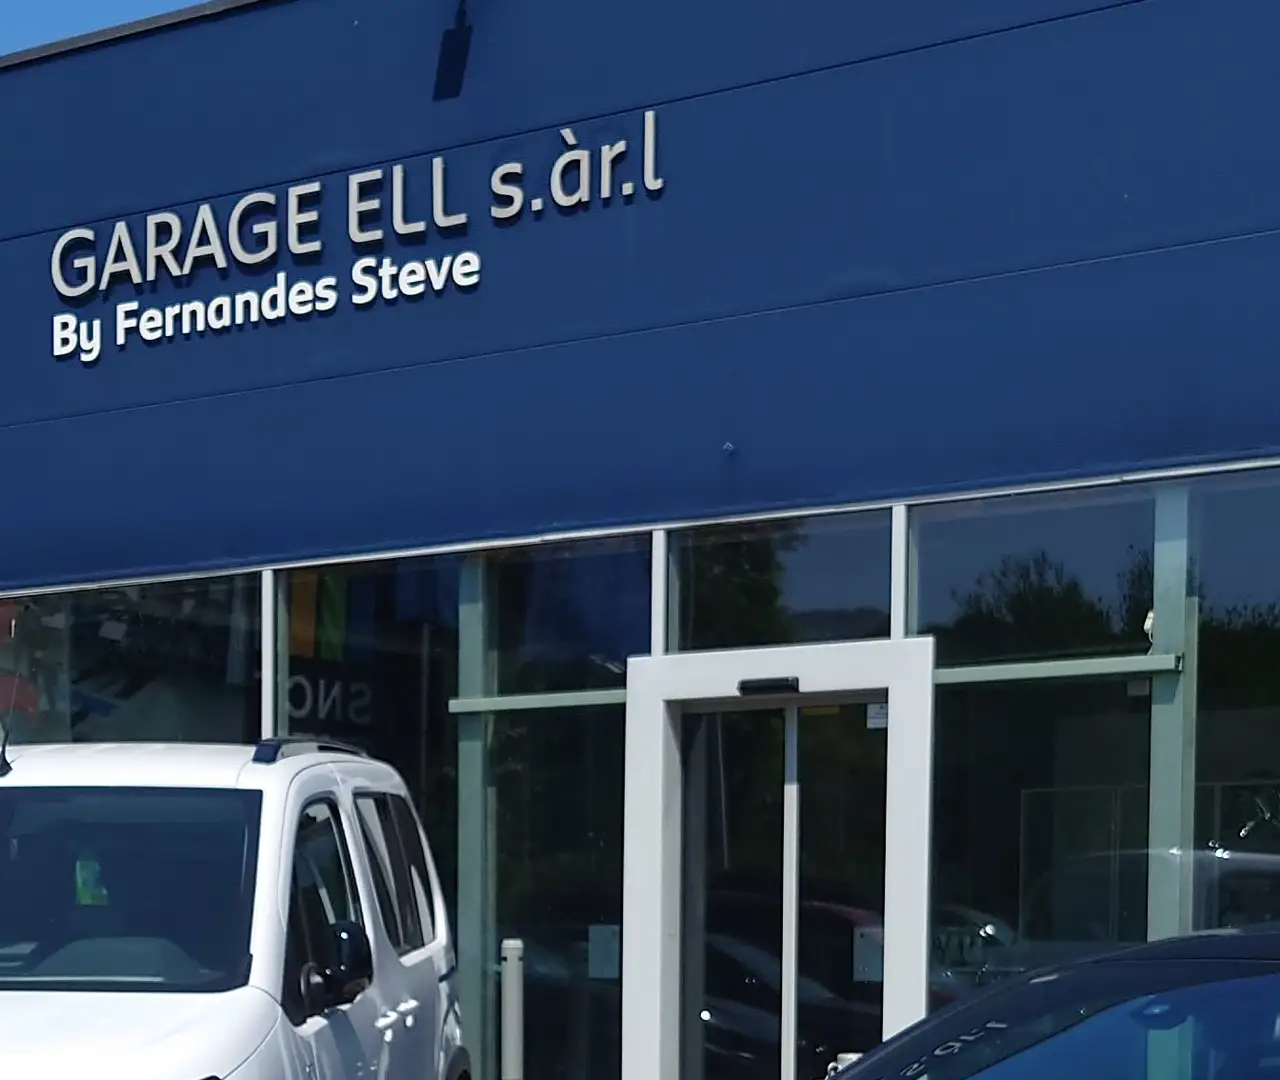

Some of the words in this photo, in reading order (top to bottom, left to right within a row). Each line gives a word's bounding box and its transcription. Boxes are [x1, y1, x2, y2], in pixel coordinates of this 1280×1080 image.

[51, 180, 321, 298] GARAGE
[347, 156, 467, 243] ELL
[490, 110, 663, 218] s.àr.l
[52, 313, 101, 362] By
[116, 271, 337, 346] Fernandes
[351, 248, 480, 304] Steve
